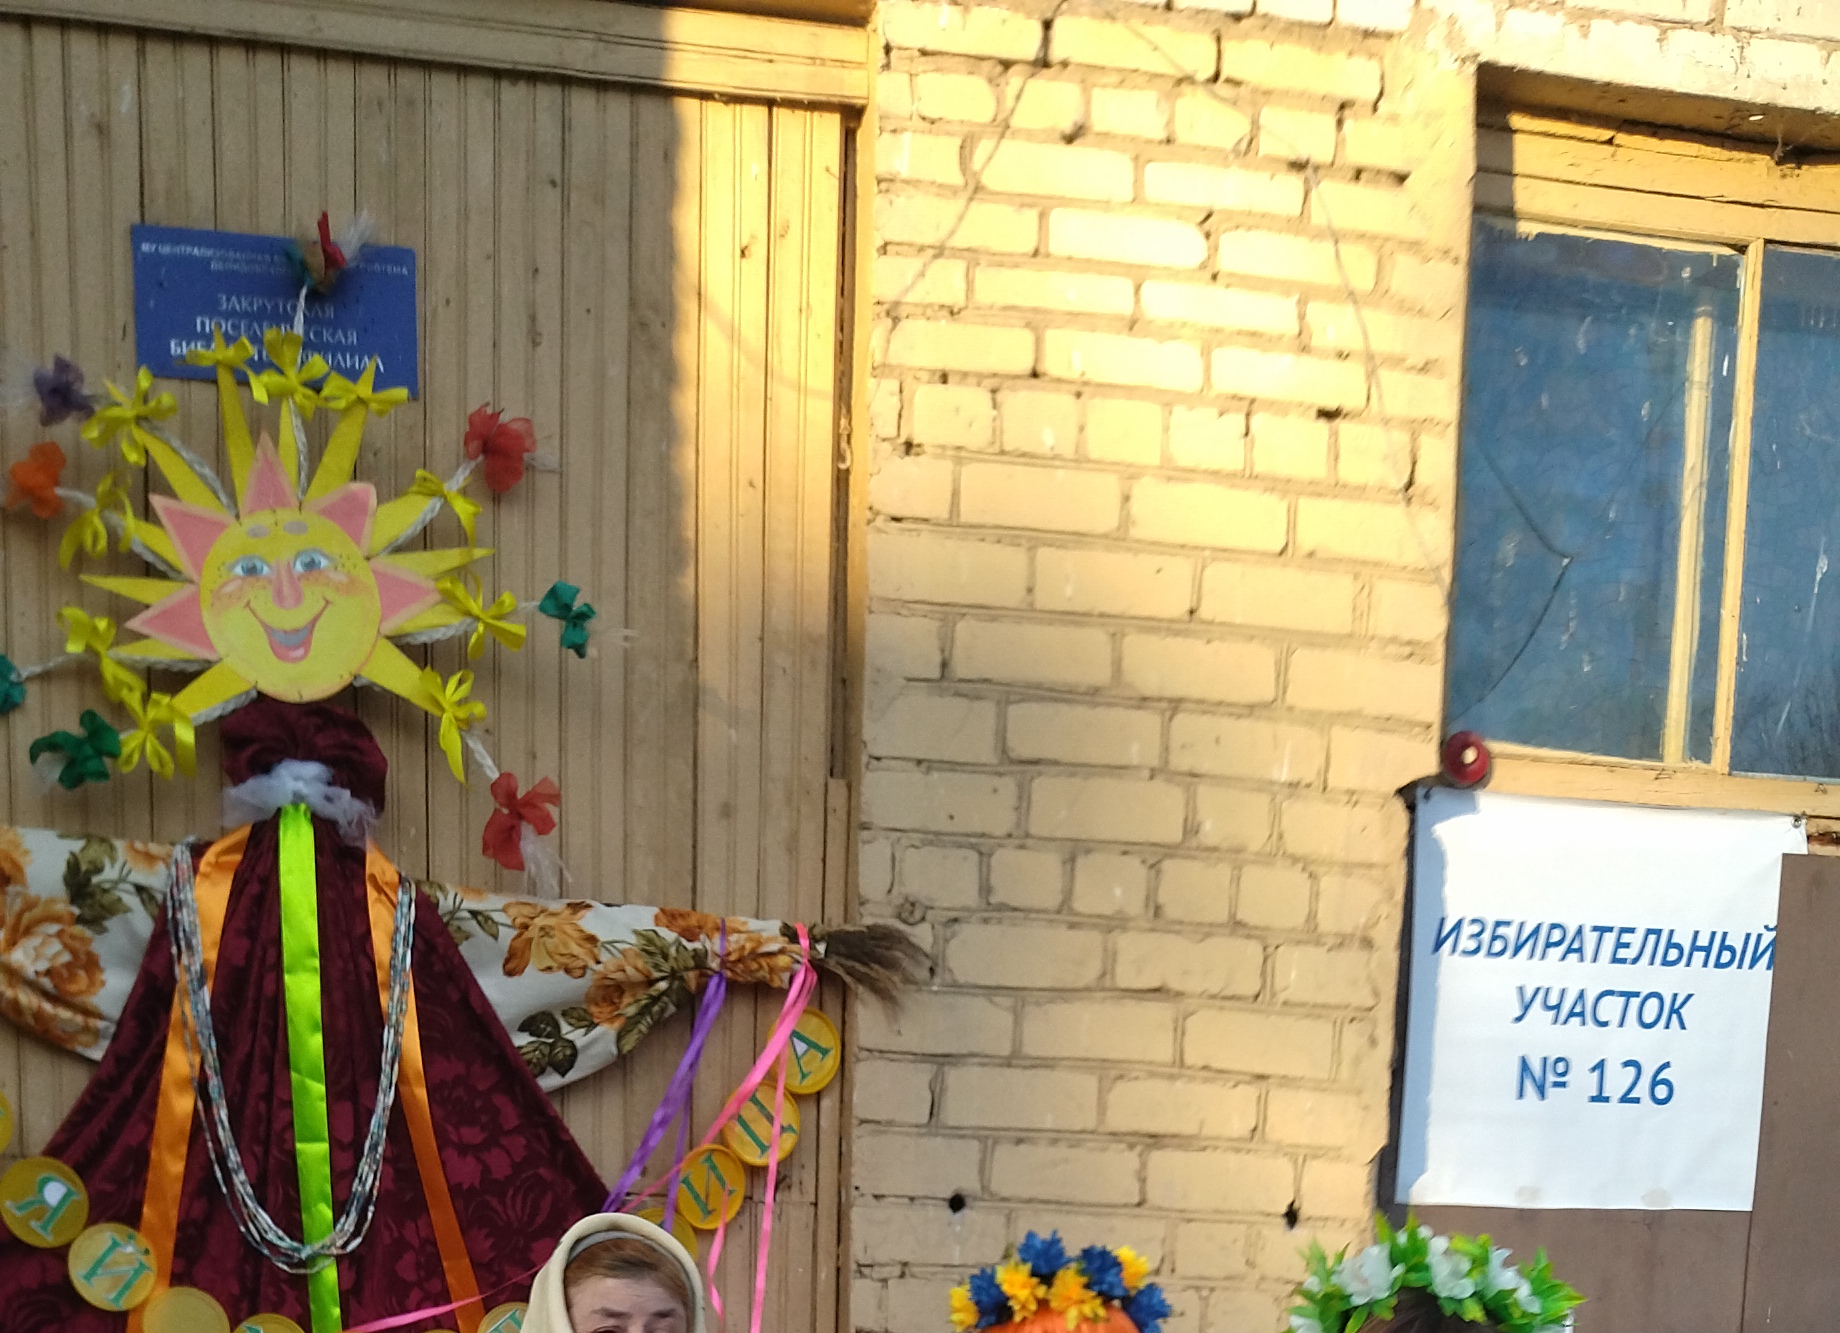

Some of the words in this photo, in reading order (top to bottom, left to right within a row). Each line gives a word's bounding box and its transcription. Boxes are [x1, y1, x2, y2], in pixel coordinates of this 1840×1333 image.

[196, 316, 357, 346] ПОСЕЛСКАЯ
[1431, 915, 1778, 972] ИЗБИРАТЕЛЬНЫЙ
[1510, 984, 1695, 1031] УЧАСТОК
[1515, 1053, 1571, 1102] №
[1587, 1057, 1676, 1106] 126
